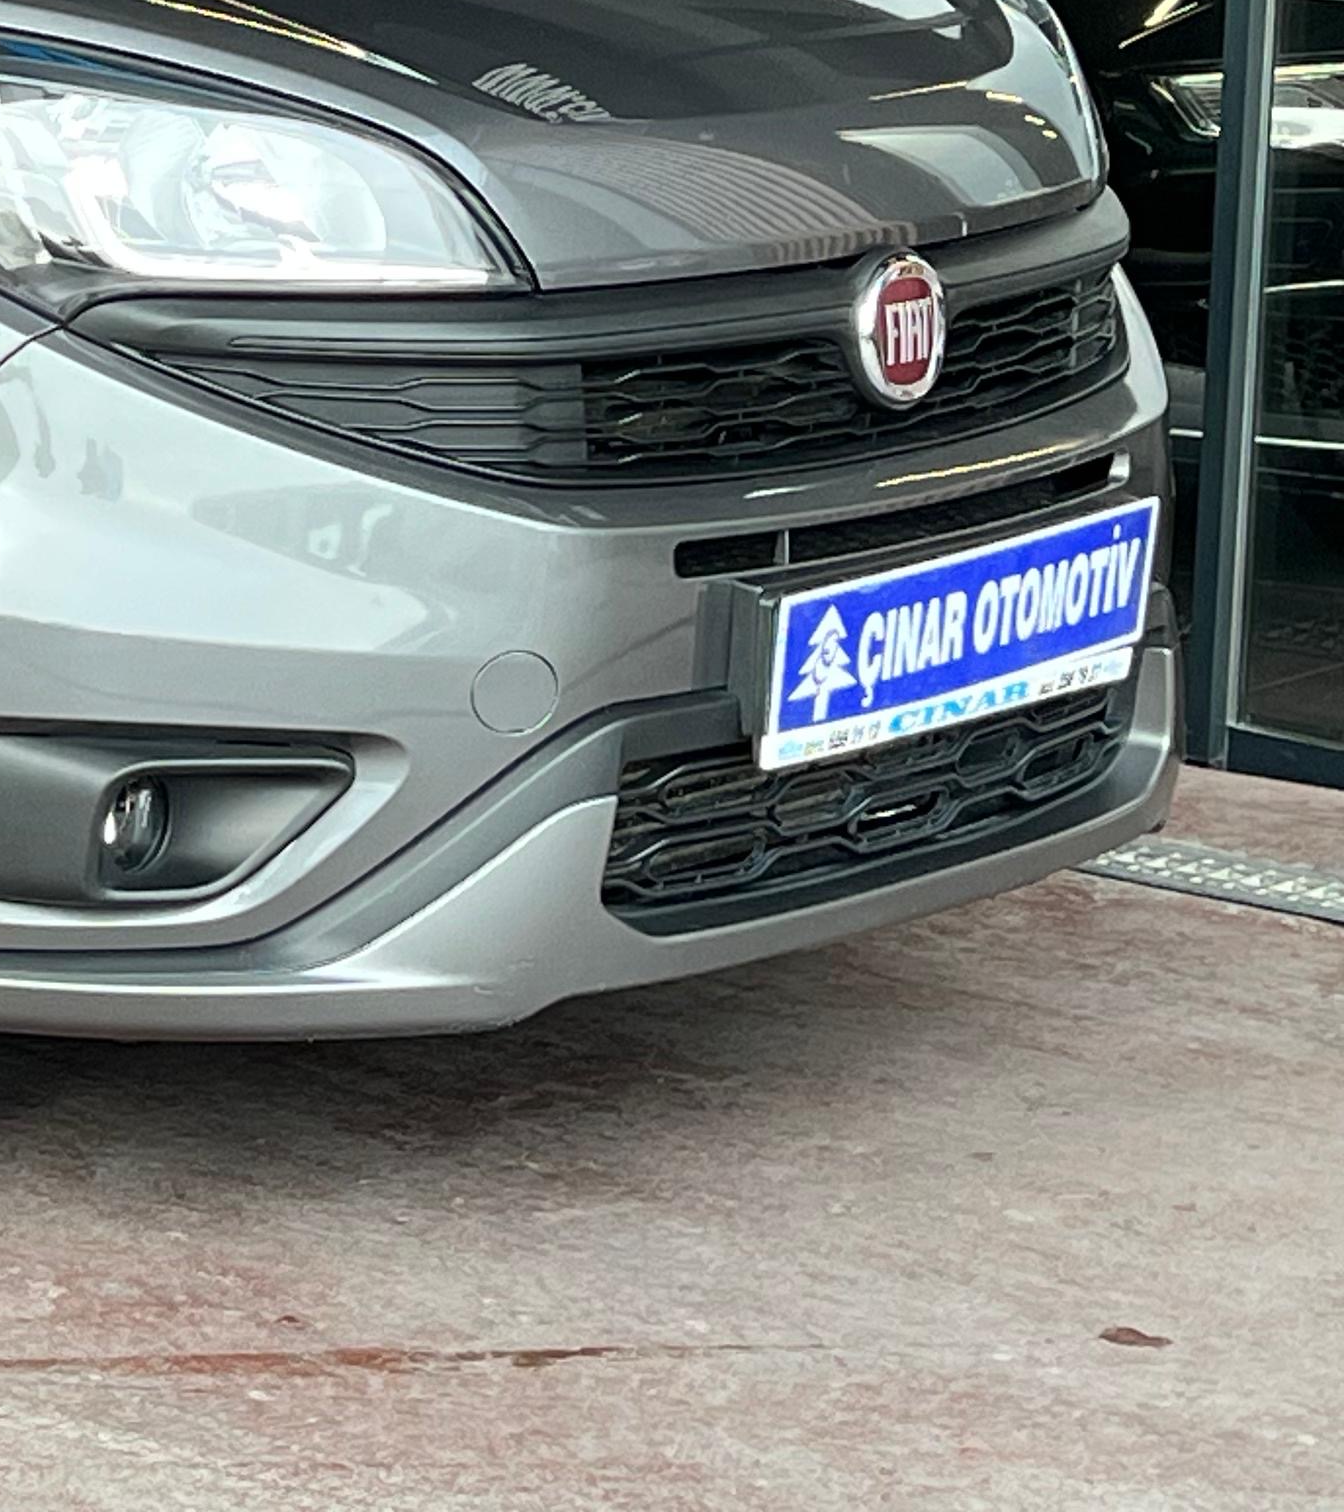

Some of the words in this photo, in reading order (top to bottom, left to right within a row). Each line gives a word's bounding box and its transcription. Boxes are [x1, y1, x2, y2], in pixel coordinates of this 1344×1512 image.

[884, 296, 932, 366] FIAT
[857, 592, 968, 708] ÇINAR
[973, 525, 1141, 654] OTOMOTİV
